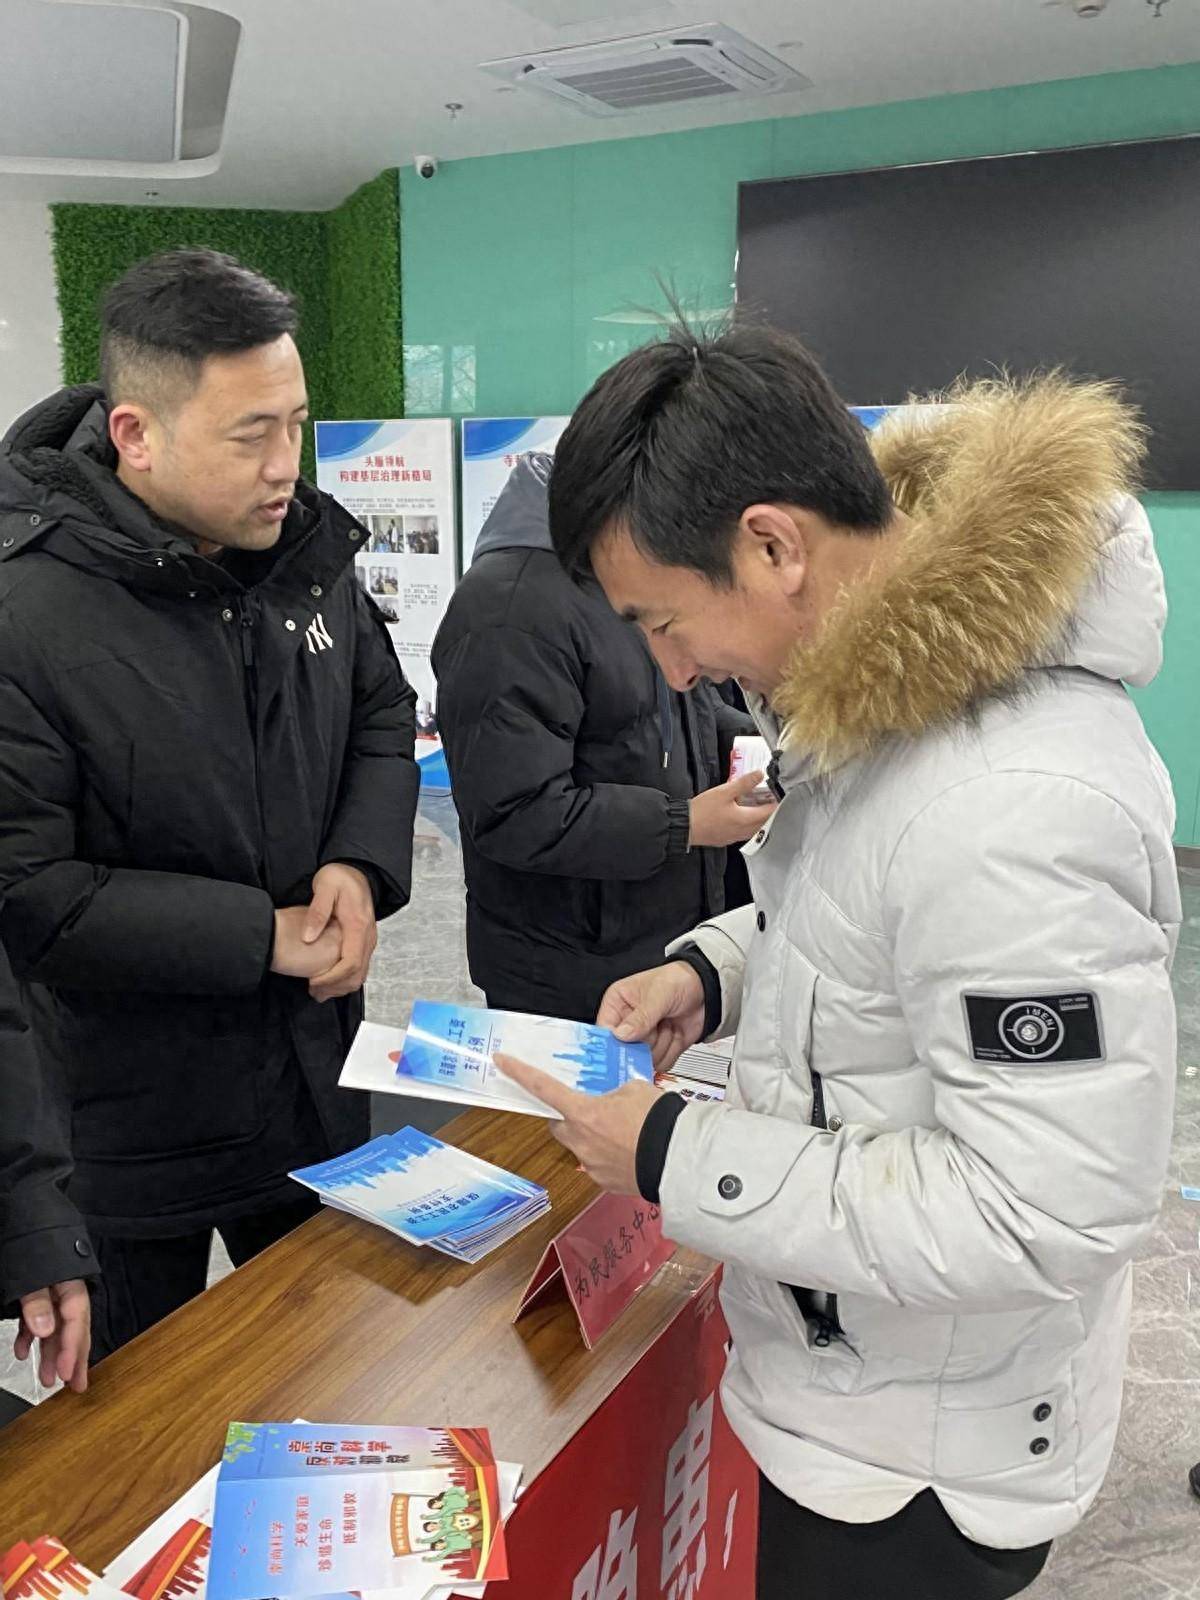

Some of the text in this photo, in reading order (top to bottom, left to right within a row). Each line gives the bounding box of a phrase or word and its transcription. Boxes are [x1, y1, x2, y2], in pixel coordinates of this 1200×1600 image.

[340, 470, 432, 482] 构建基层治理新格局
[288, 1439, 393, 1454] 崇尚科学
[343, 1492, 358, 1545] 抵制邪教
